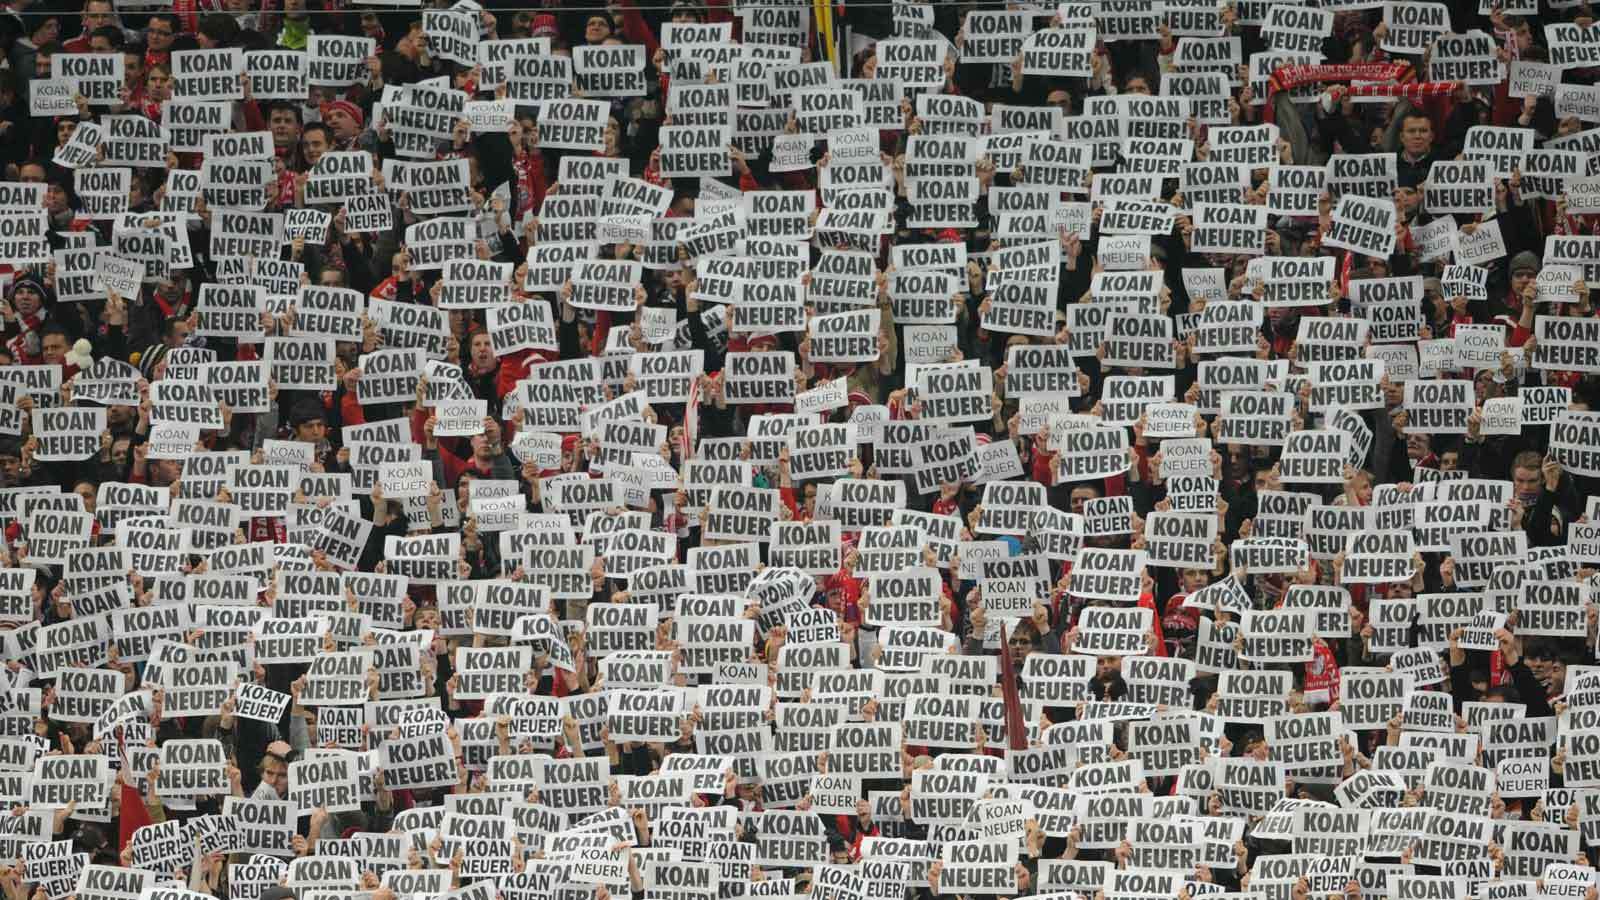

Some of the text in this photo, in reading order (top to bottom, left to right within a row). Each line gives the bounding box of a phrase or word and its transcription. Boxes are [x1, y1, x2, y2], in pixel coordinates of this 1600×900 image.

[752, 9, 800, 28] KOAN
[970, 15, 1022, 33] KOAN
[1392, 5, 1443, 25] KOAN
[426, 13, 471, 38] KOAN
[1035, 33, 1086, 48] KOAN
[1437, 38, 1489, 56] KOAN
[583, 49, 635, 67] KOAN
[885, 45, 936, 61] KOAN
[1181, 41, 1230, 60] KOAN
[61, 58, 113, 75] KOAN
[180, 53, 232, 72] KOAN
[247, 55, 298, 70] KOAN
[514, 58, 565, 77] KOAN
[1024, 52, 1091, 70] NEUER!
[1432, 61, 1497, 79] NEUER!
[577, 72, 645, 90] NEUER!
[1519, 68, 1552, 80] KOAN
[37, 85, 69, 95] KOAN
[174, 76, 241, 95] NEUER!
[506, 80, 572, 101] NEUER!
[801, 94, 852, 110] KOAN
[1562, 91, 1595, 103] KOAN
[547, 103, 599, 120] KOAN
[538, 124, 603, 144] NEUER!
[669, 129, 720, 147] KOAN
[836, 134, 870, 144] KOAN
[1217, 129, 1269, 143] KOAN
[103, 141, 167, 161] NEUER!
[213, 137, 264, 156] KOAN
[1029, 143, 1081, 163] KOAN
[1211, 146, 1277, 162] NEUER!
[663, 152, 729, 171] NEUER!
[830, 166, 882, 182] KOAN
[1433, 165, 1485, 183] KOAN
[348, 195, 386, 212] KOAN
[1426, 189, 1492, 206] NEUER!
[212, 237, 279, 257] NEUER!
[1106, 240, 1141, 249] KOAN
[449, 262, 502, 280] KOAN
[1446, 265, 1483, 281] KOAN
[743, 284, 796, 301] KOAN
[895, 276, 947, 293] KOAN
[1444, 282, 1486, 297] NEUER!
[204, 288, 255, 307] KOAN
[302, 289, 355, 312] KOAN
[496, 303, 544, 324] KOAN
[734, 307, 803, 324] NEUER!
[1372, 305, 1415, 322] KOAN
[292, 313, 360, 333] NEUER!
[1112, 317, 1165, 337] KOAN
[1307, 321, 1357, 340] KOAN
[1369, 324, 1420, 338] NEUER!
[493, 327, 554, 348] NEUER!
[913, 332, 948, 342] KOAN
[1464, 335, 1499, 348] KOAN
[1015, 350, 1068, 367] KOAN
[1104, 342, 1173, 362] NEUER!
[732, 356, 785, 374] KOAN
[1319, 363, 1373, 381] KOAN
[725, 380, 793, 397] NEUER!
[1007, 372, 1077, 391] NEUER!
[158, 385, 213, 401] KOAN
[151, 405, 221, 424] NEUER!
[444, 406, 477, 416] KOAN
[1152, 408, 1188, 419] KOAN
[42, 411, 95, 430] KOAN
[234, 468, 288, 487] KOAN
[388, 468, 423, 478] KOAN
[1171, 478, 1215, 492] KOAN
[106, 486, 158, 505] KOAN
[717, 490, 771, 512] KOAN
[480, 501, 516, 510] KOAN
[779, 526, 830, 544] KOAN
[1153, 516, 1207, 537] KOAN
[395, 538, 449, 556] KOAN
[1353, 534, 1407, 552] KOAN
[771, 549, 838, 568] NEUER!
[1080, 552, 1135, 571] KOAN
[988, 582, 1026, 593] KOAN
[1069, 574, 1140, 595] NEUER!
[485, 585, 541, 607] KOAN
[984, 597, 1032, 609] NEUER!
[1525, 585, 1579, 605] KOAN
[123, 608, 179, 631] KOAN
[791, 611, 834, 626] KOAN
[868, 602, 939, 620] NEUER!
[1086, 610, 1142, 629] KOAN
[1516, 610, 1585, 629] NEUER!
[262, 621, 317, 634] KOAN
[786, 626, 840, 644] NEUER!
[1077, 632, 1146, 650] NEUER!
[1395, 650, 1433, 668] KOAN
[1227, 675, 1283, 694] KOAN
[1347, 678, 1403, 698] KOAN
[241, 684, 286, 704] KOAN
[706, 689, 760, 706] KOAN
[1410, 695, 1447, 710] KOAN
[514, 701, 558, 715] KOAN
[1085, 704, 1155, 719] NEUER!
[509, 719, 562, 733] NEUER!
[1403, 711, 1451, 727] NEUER!
[836, 727, 891, 747] KOAN
[1134, 724, 1190, 744] KOAN
[166, 744, 220, 763] KOAN
[388, 737, 443, 763] KOAN
[41, 759, 96, 778] KOAN
[827, 753, 900, 772] NEUER!
[1502, 763, 1541, 774] KOAN
[157, 769, 227, 788] NEUER!
[384, 762, 456, 785] NEUER!
[544, 762, 599, 783] KOAN
[1431, 766, 1486, 790] KOAN
[815, 778, 852, 790] KOAN
[33, 784, 103, 803] NEUER!
[986, 804, 1022, 818] KOAN
[762, 815, 819, 835] KOAN
[1303, 812, 1358, 832] KOAN
[26, 843, 68, 859] KOAN
[466, 840, 510, 856] KOAN
[581, 849, 620, 861] KOAN
[757, 840, 826, 860] NEUER!
[574, 864, 623, 877] NEUER!
[820, 867, 862, 891] KOAN
[1549, 870, 1588, 881] KOAN
